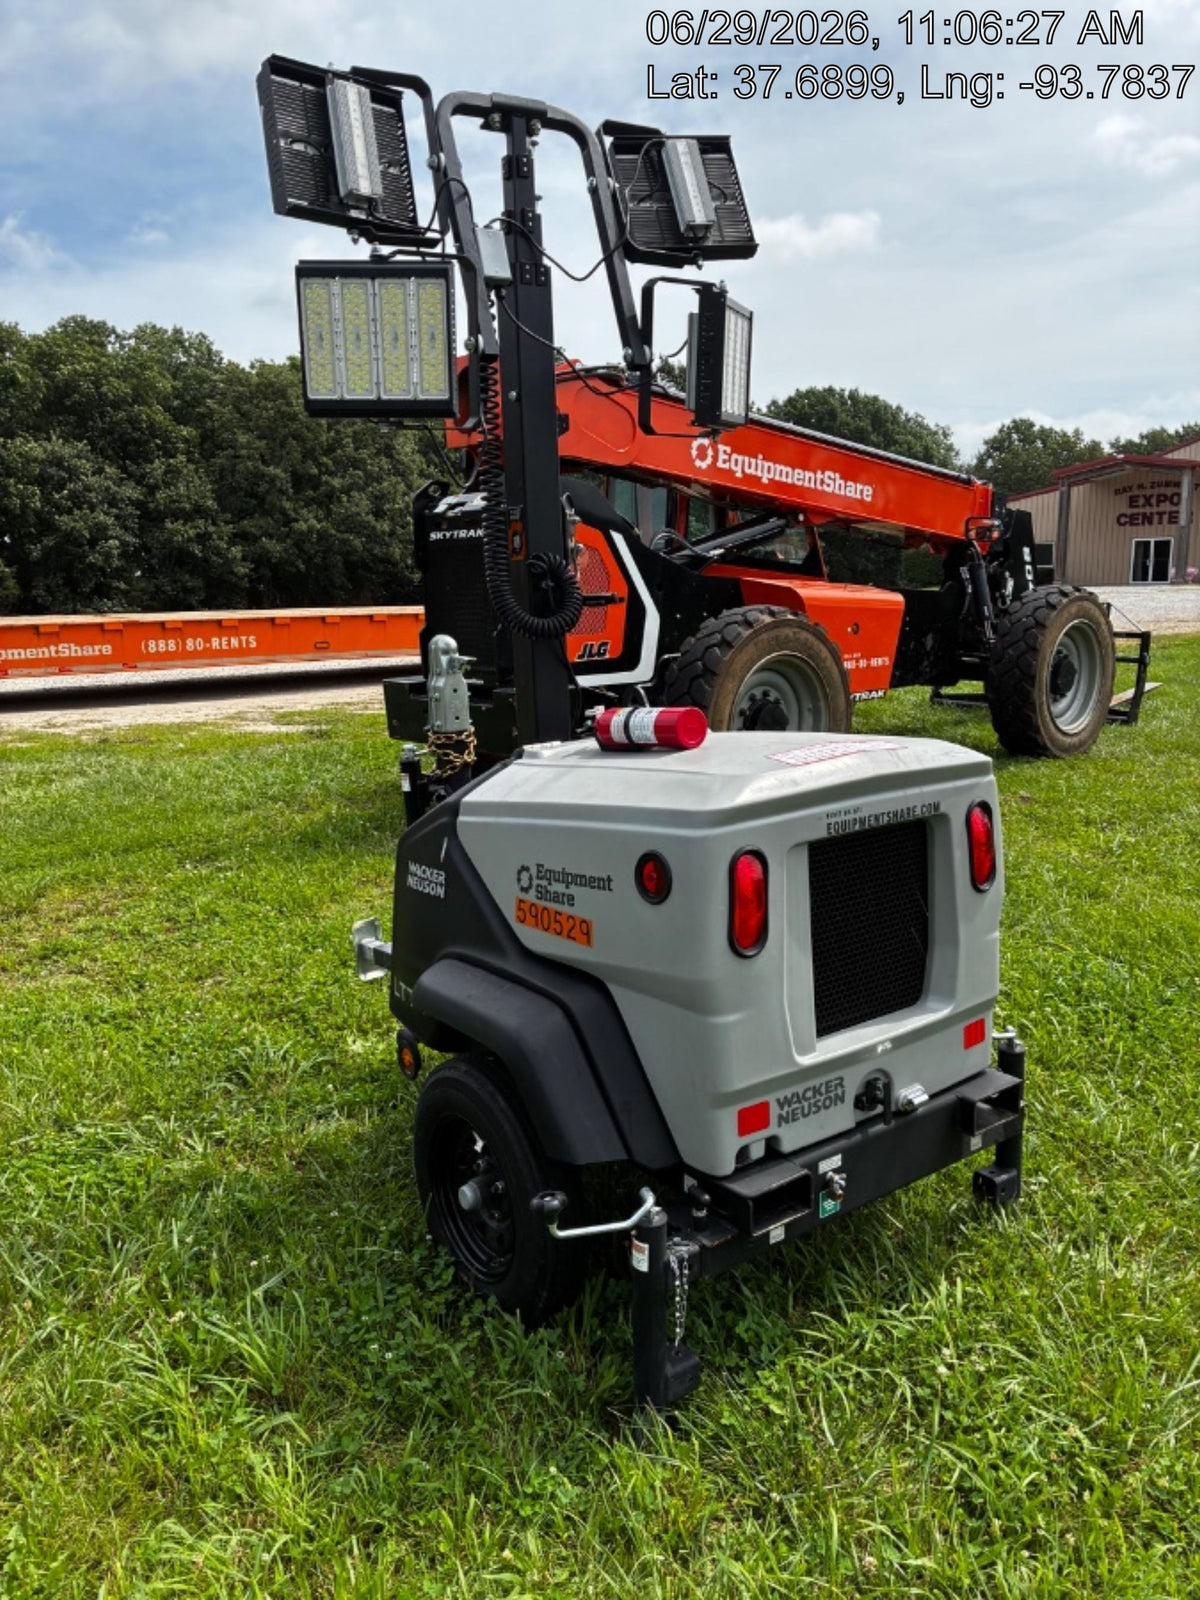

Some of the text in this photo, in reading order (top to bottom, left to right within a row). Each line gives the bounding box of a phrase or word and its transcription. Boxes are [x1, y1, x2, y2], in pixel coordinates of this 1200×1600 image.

[716, 444, 873, 502] EquipmentShare
[1128, 492, 1181, 509] EXPO
[1116, 510, 1194, 527] CENTE
[141, 635, 257, 654] (888) 80-RENTS
[576, 641, 611, 662] JLG
[826, 801, 941, 836] EQUIPMENTSHARE.COM
[408, 860, 446, 884] WACKER
[536, 863, 613, 892] Equipment
[406, 873, 446, 899] NEUSON
[535, 883, 575, 908] Share
[516, 899, 592, 947] 590529
[776, 1076, 846, 1112] WACKER
[777, 1089, 846, 1128] NEUSON
